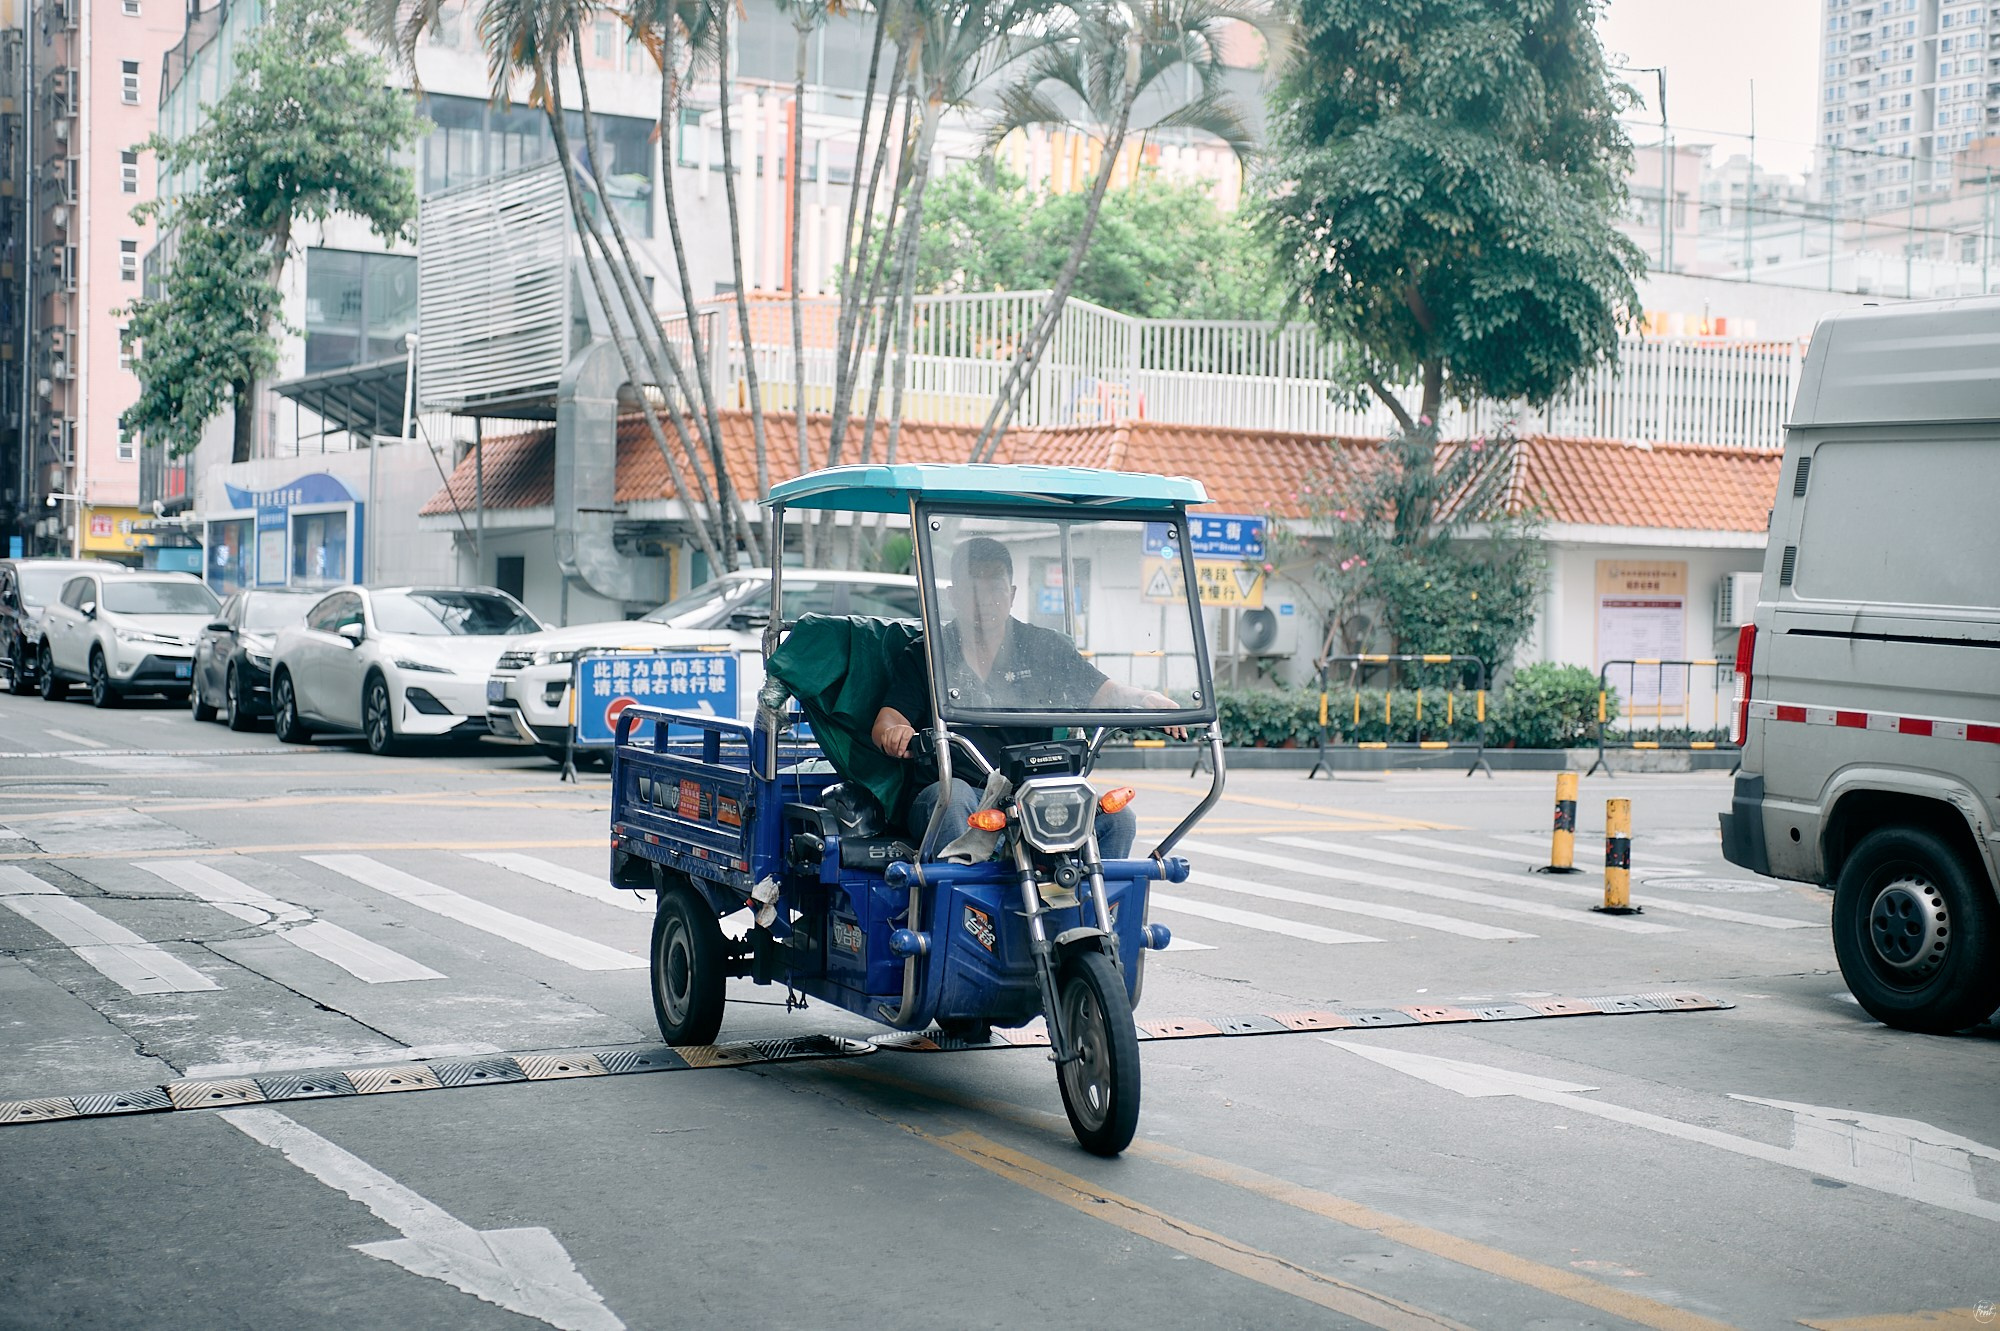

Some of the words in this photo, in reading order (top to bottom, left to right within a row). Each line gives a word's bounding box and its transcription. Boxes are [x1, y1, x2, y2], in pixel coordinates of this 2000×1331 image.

[1219, 541, 1241, 552] Street
[593, 658, 725, 678] 此路为单向车道
[593, 676, 725, 696] 请车辆右转行驶
